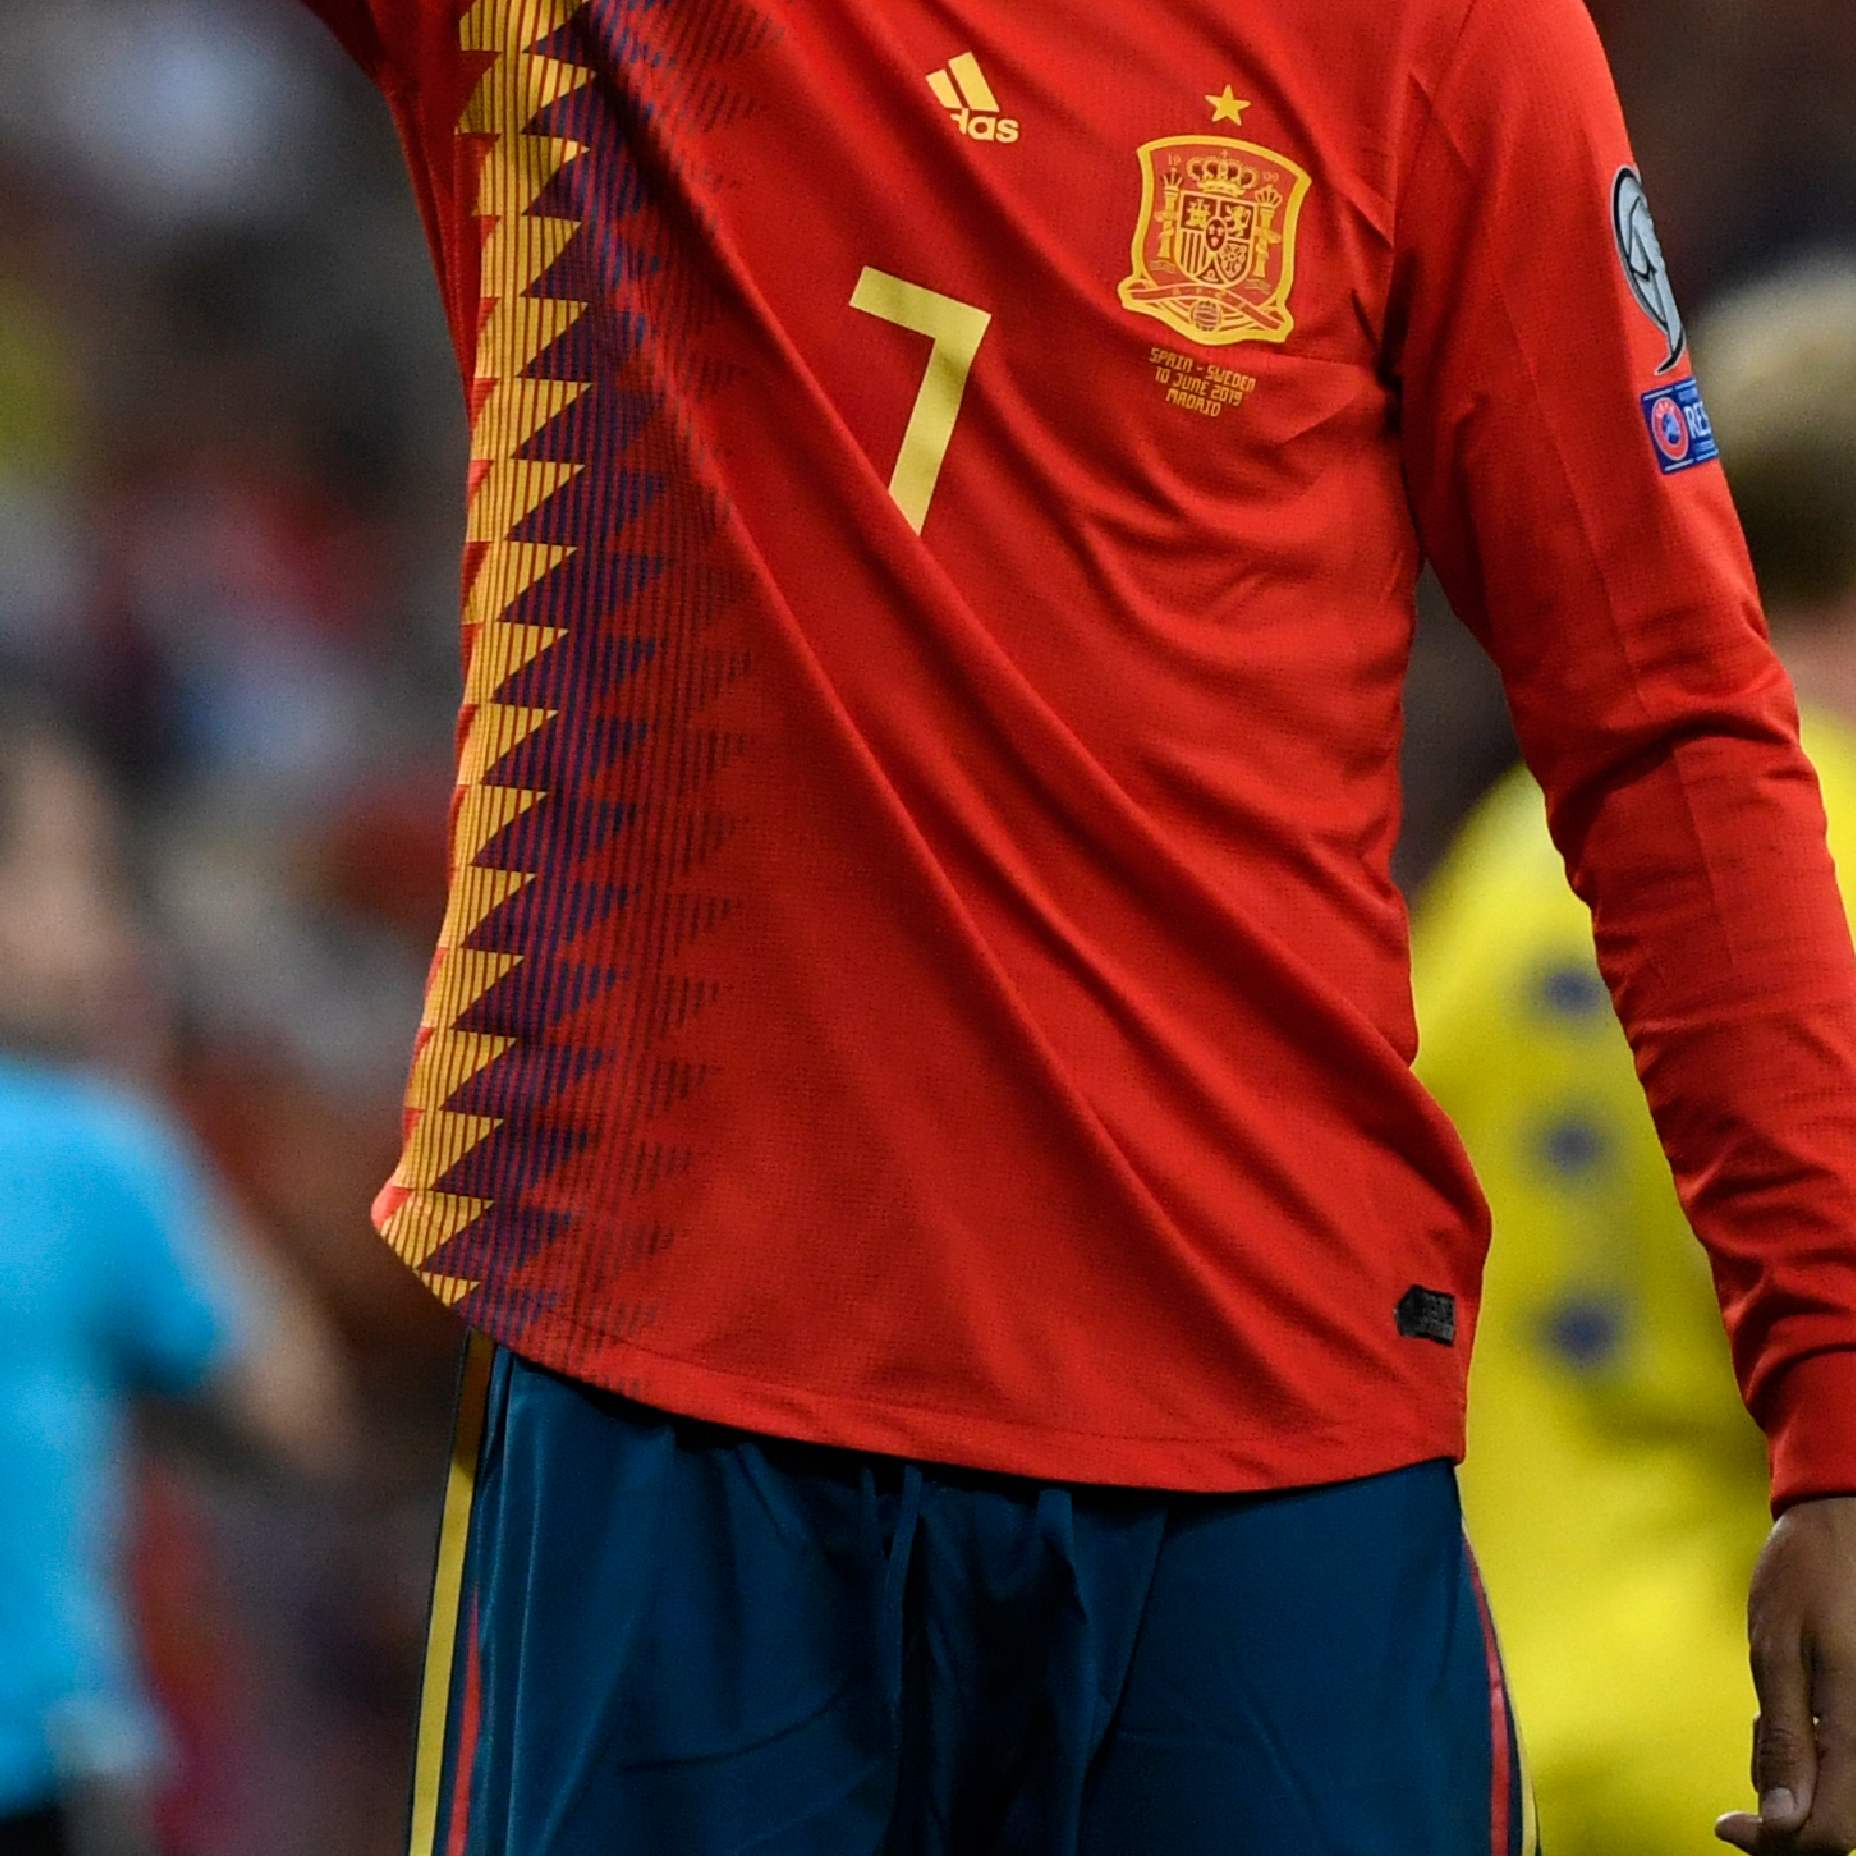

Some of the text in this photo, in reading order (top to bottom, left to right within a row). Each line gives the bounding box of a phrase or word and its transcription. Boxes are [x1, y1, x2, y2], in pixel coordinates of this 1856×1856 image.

[1149, 347, 1194, 374] SPAIN
[1205, 364, 1257, 393] SWEDEN
[1155, 366, 1243, 407] 10 JUNE 2019
[848, 265, 992, 537] 7
[1165, 388, 1221, 417] MADRID
